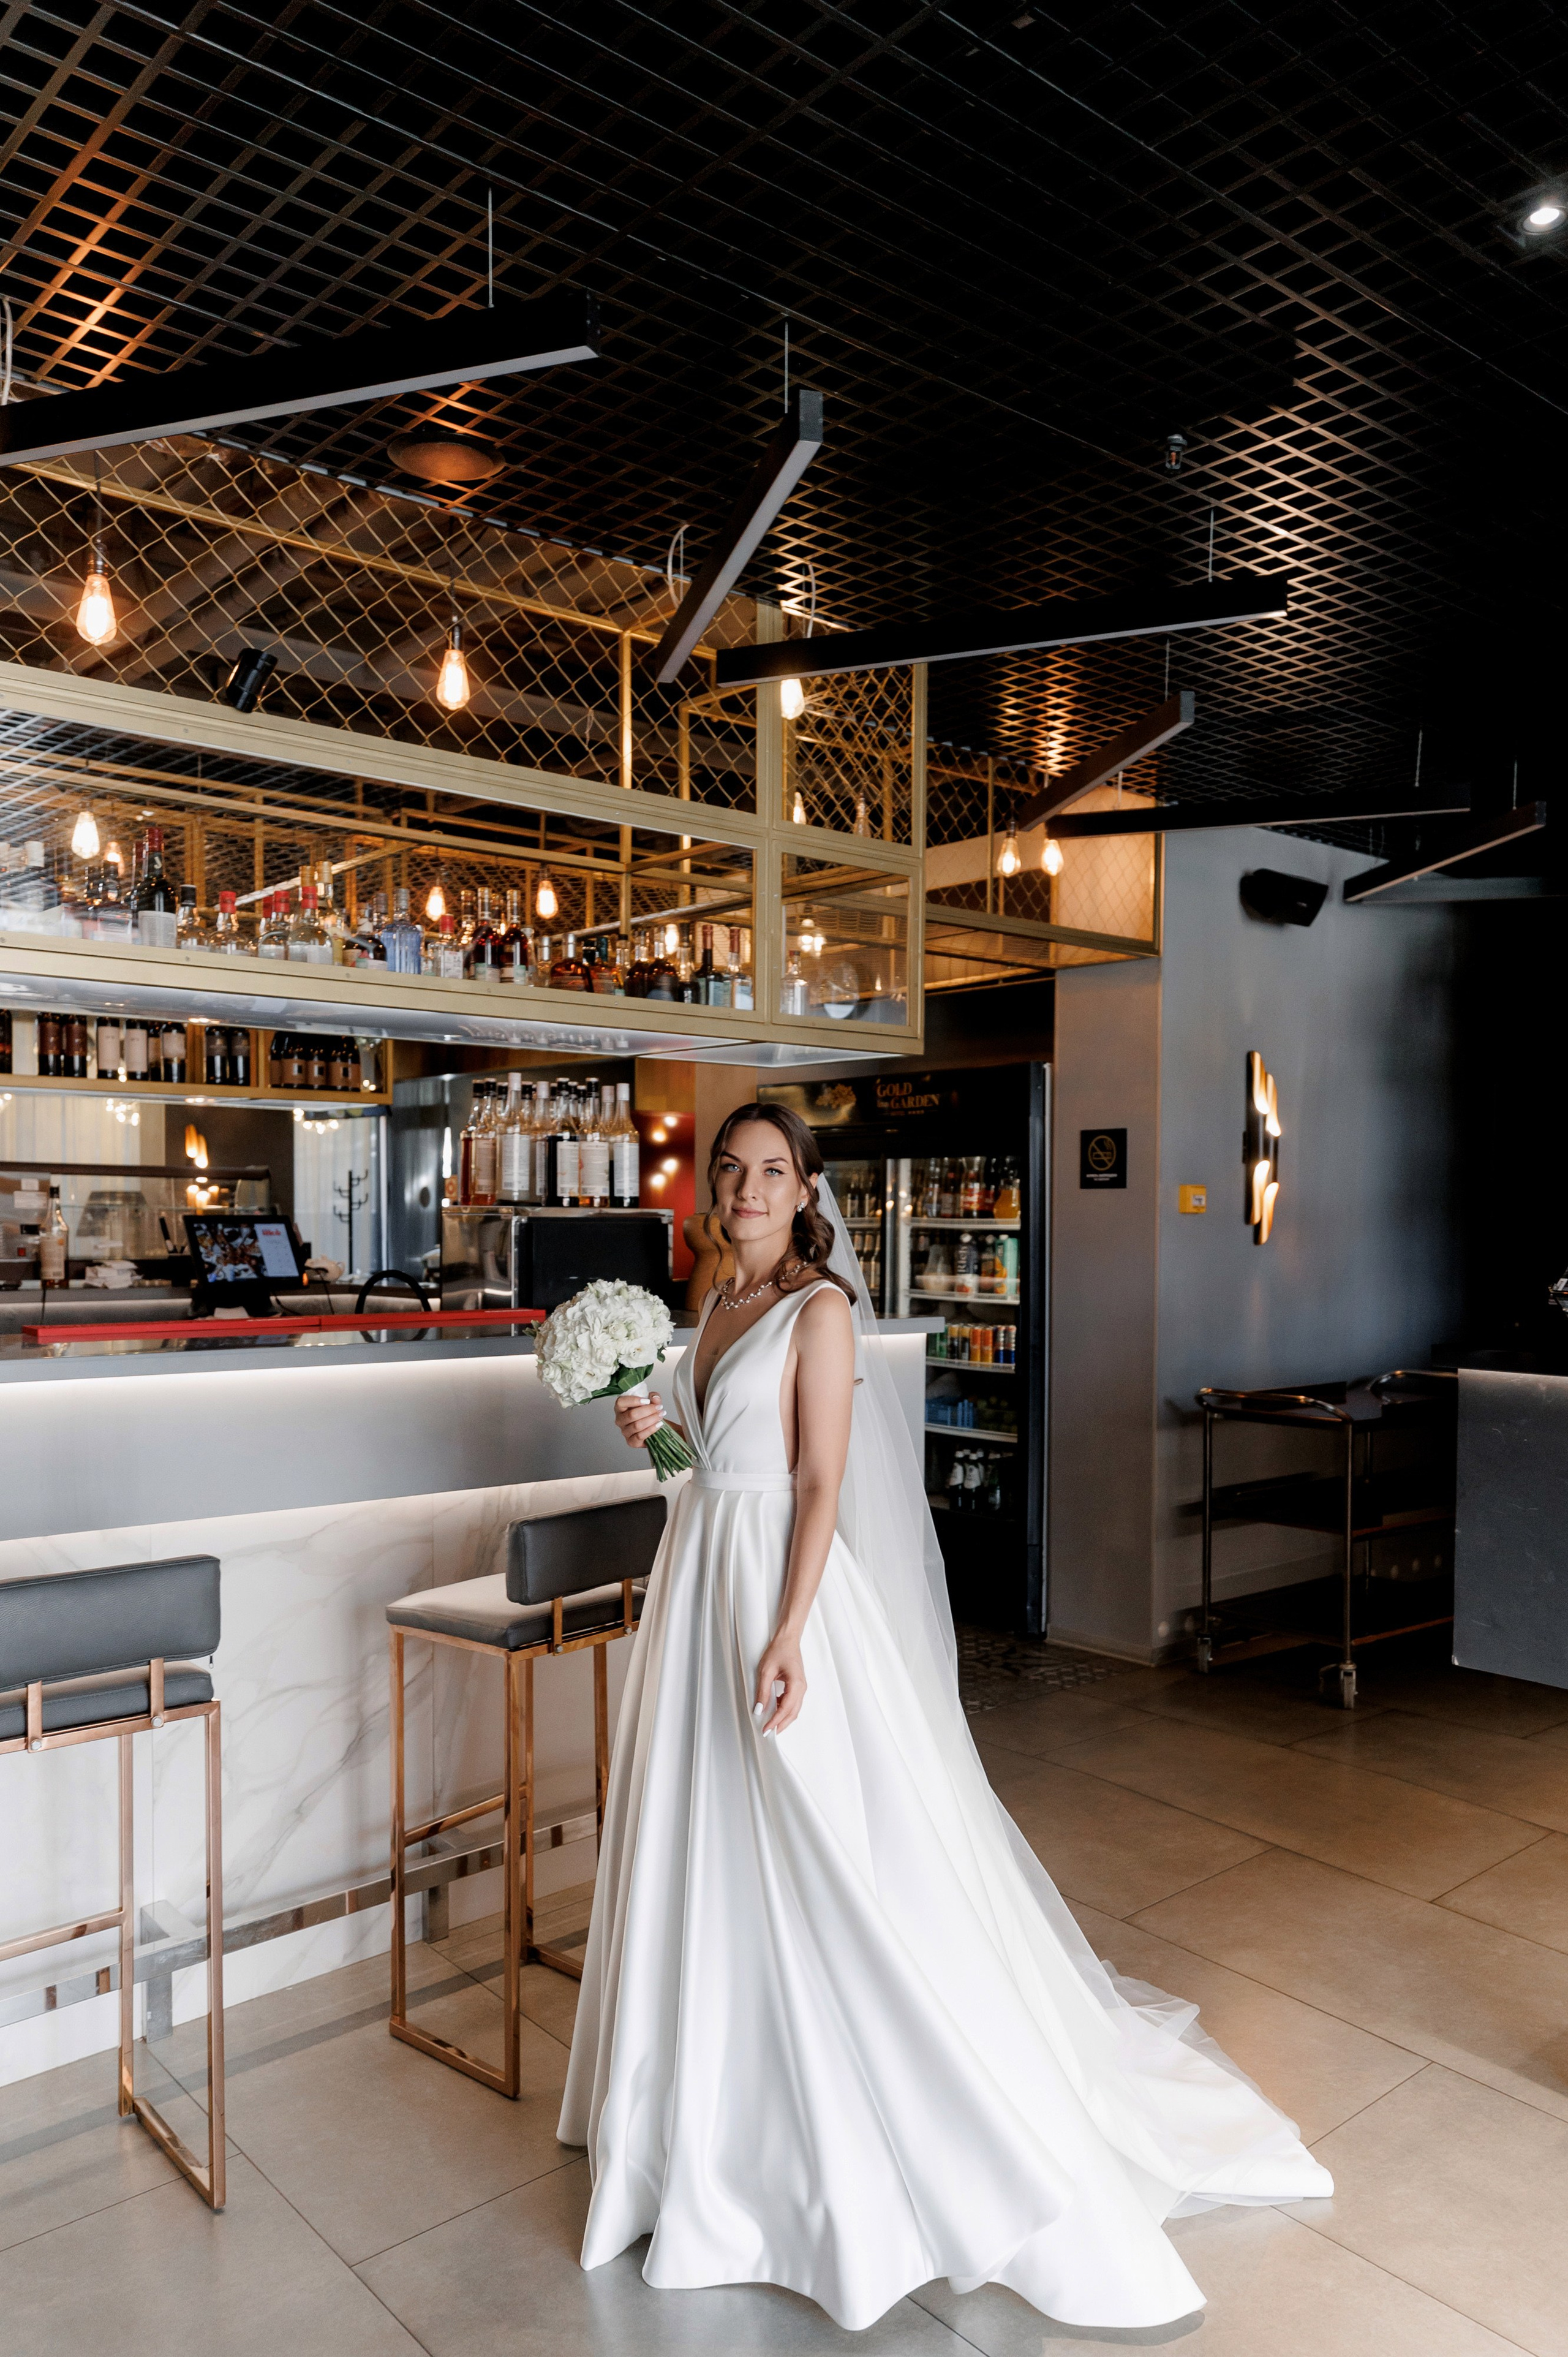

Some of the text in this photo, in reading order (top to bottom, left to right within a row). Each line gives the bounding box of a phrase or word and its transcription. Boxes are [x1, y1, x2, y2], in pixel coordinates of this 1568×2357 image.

[154, 856, 162, 869] J
[876, 1082, 913, 1097] GOLD
[890, 1094, 940, 1109] GARDEN
[957, 1246, 968, 1273] Rich
